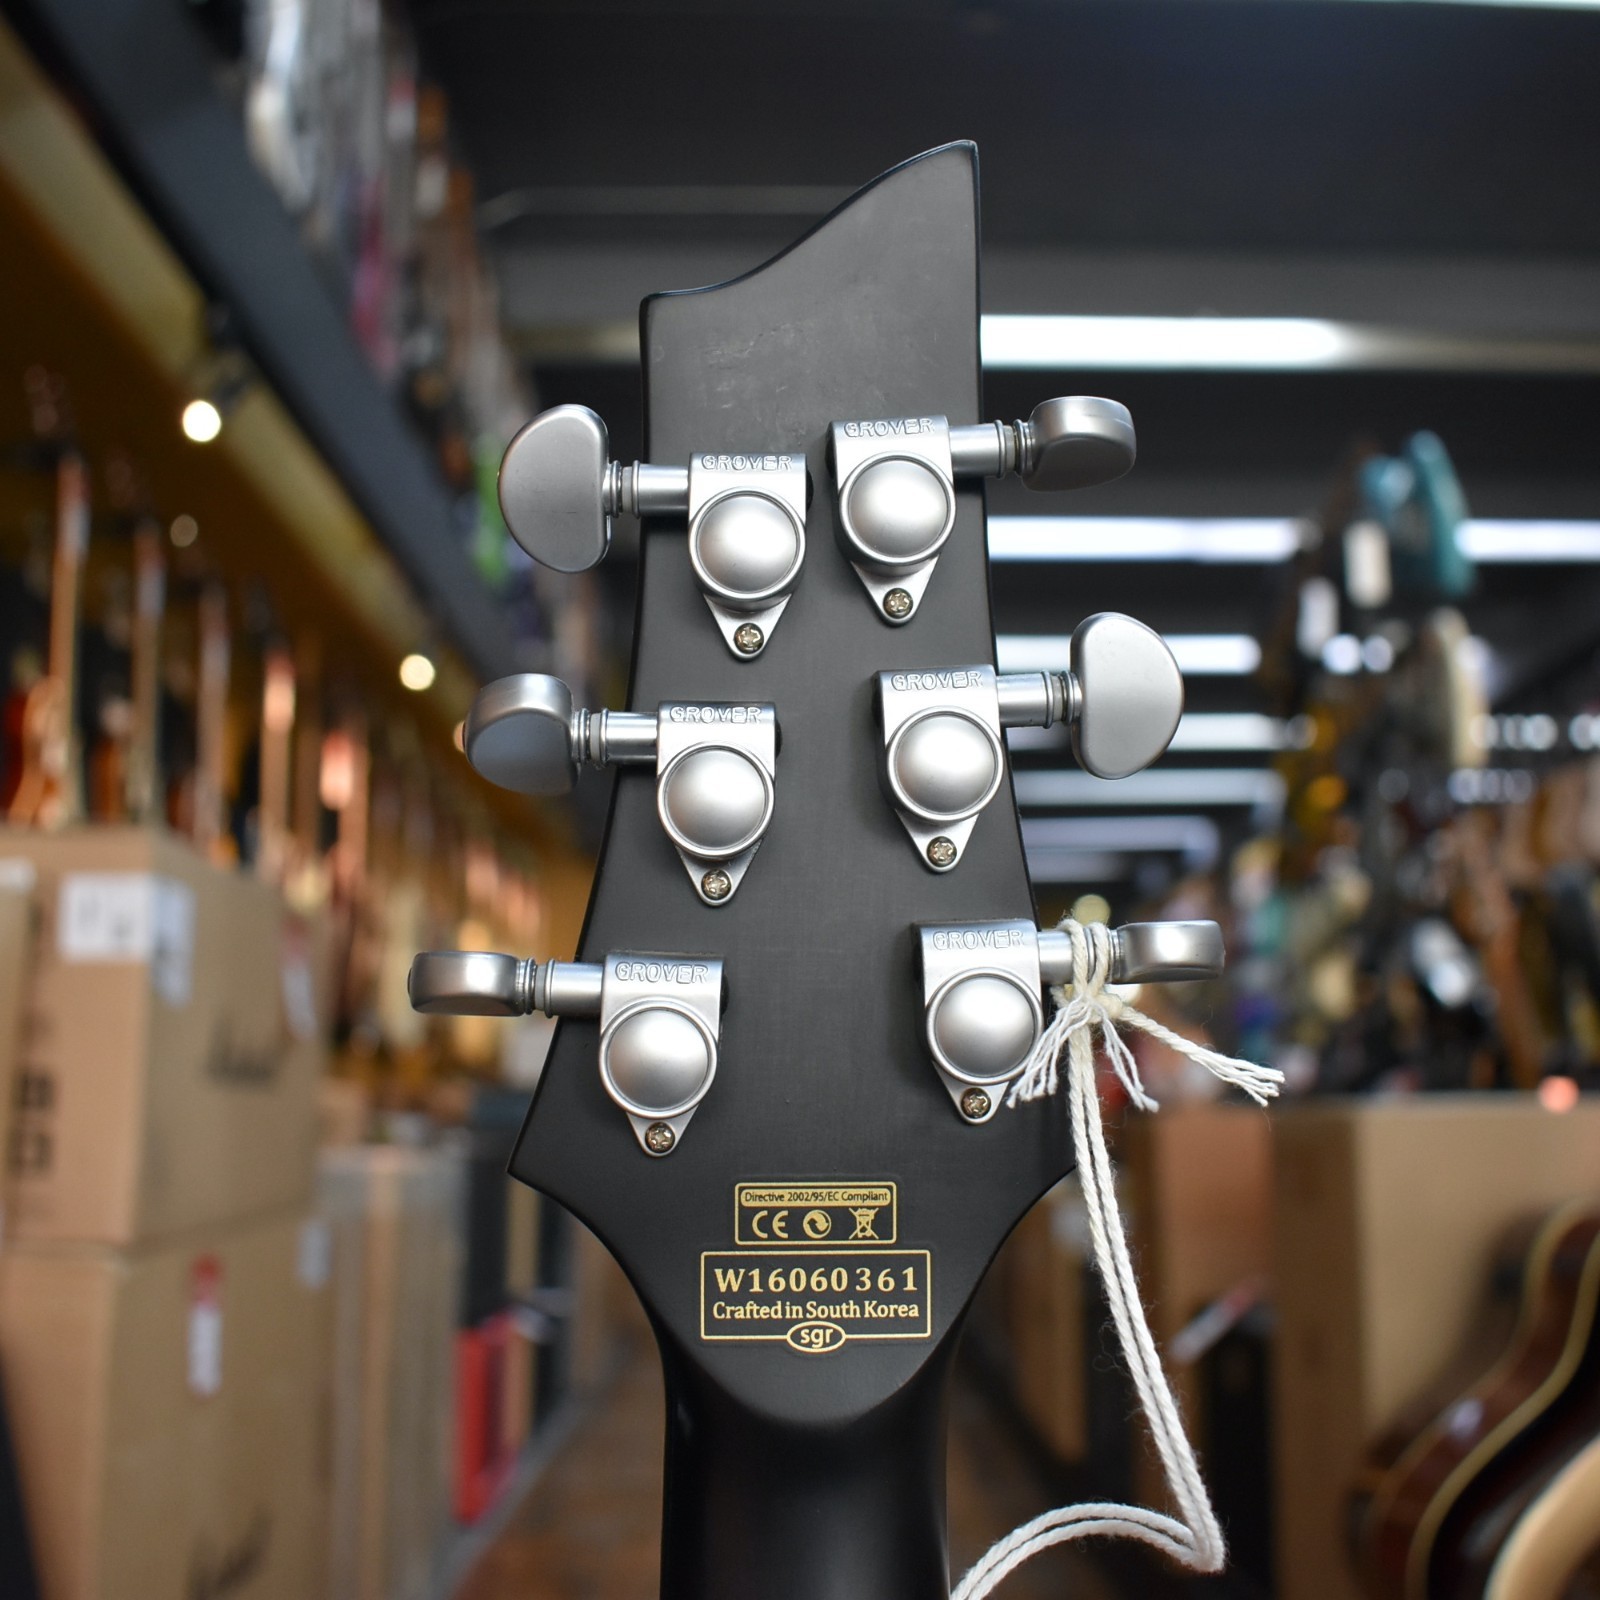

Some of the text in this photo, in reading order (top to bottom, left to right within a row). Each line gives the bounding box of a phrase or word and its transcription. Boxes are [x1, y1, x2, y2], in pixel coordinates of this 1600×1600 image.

[843, 418, 935, 438] GROVER
[701, 455, 792, 471] GROVER
[890, 670, 984, 692] GROVER
[669, 706, 762, 725] GROVER
[932, 929, 1025, 950] GROVER
[615, 962, 709, 985] GROVER
[745, 1191, 888, 1203] Directive 2002/95/EC Compliant
[713, 1301, 919, 1319] Crafted in South Korea
[800, 1328, 834, 1348] sgr
